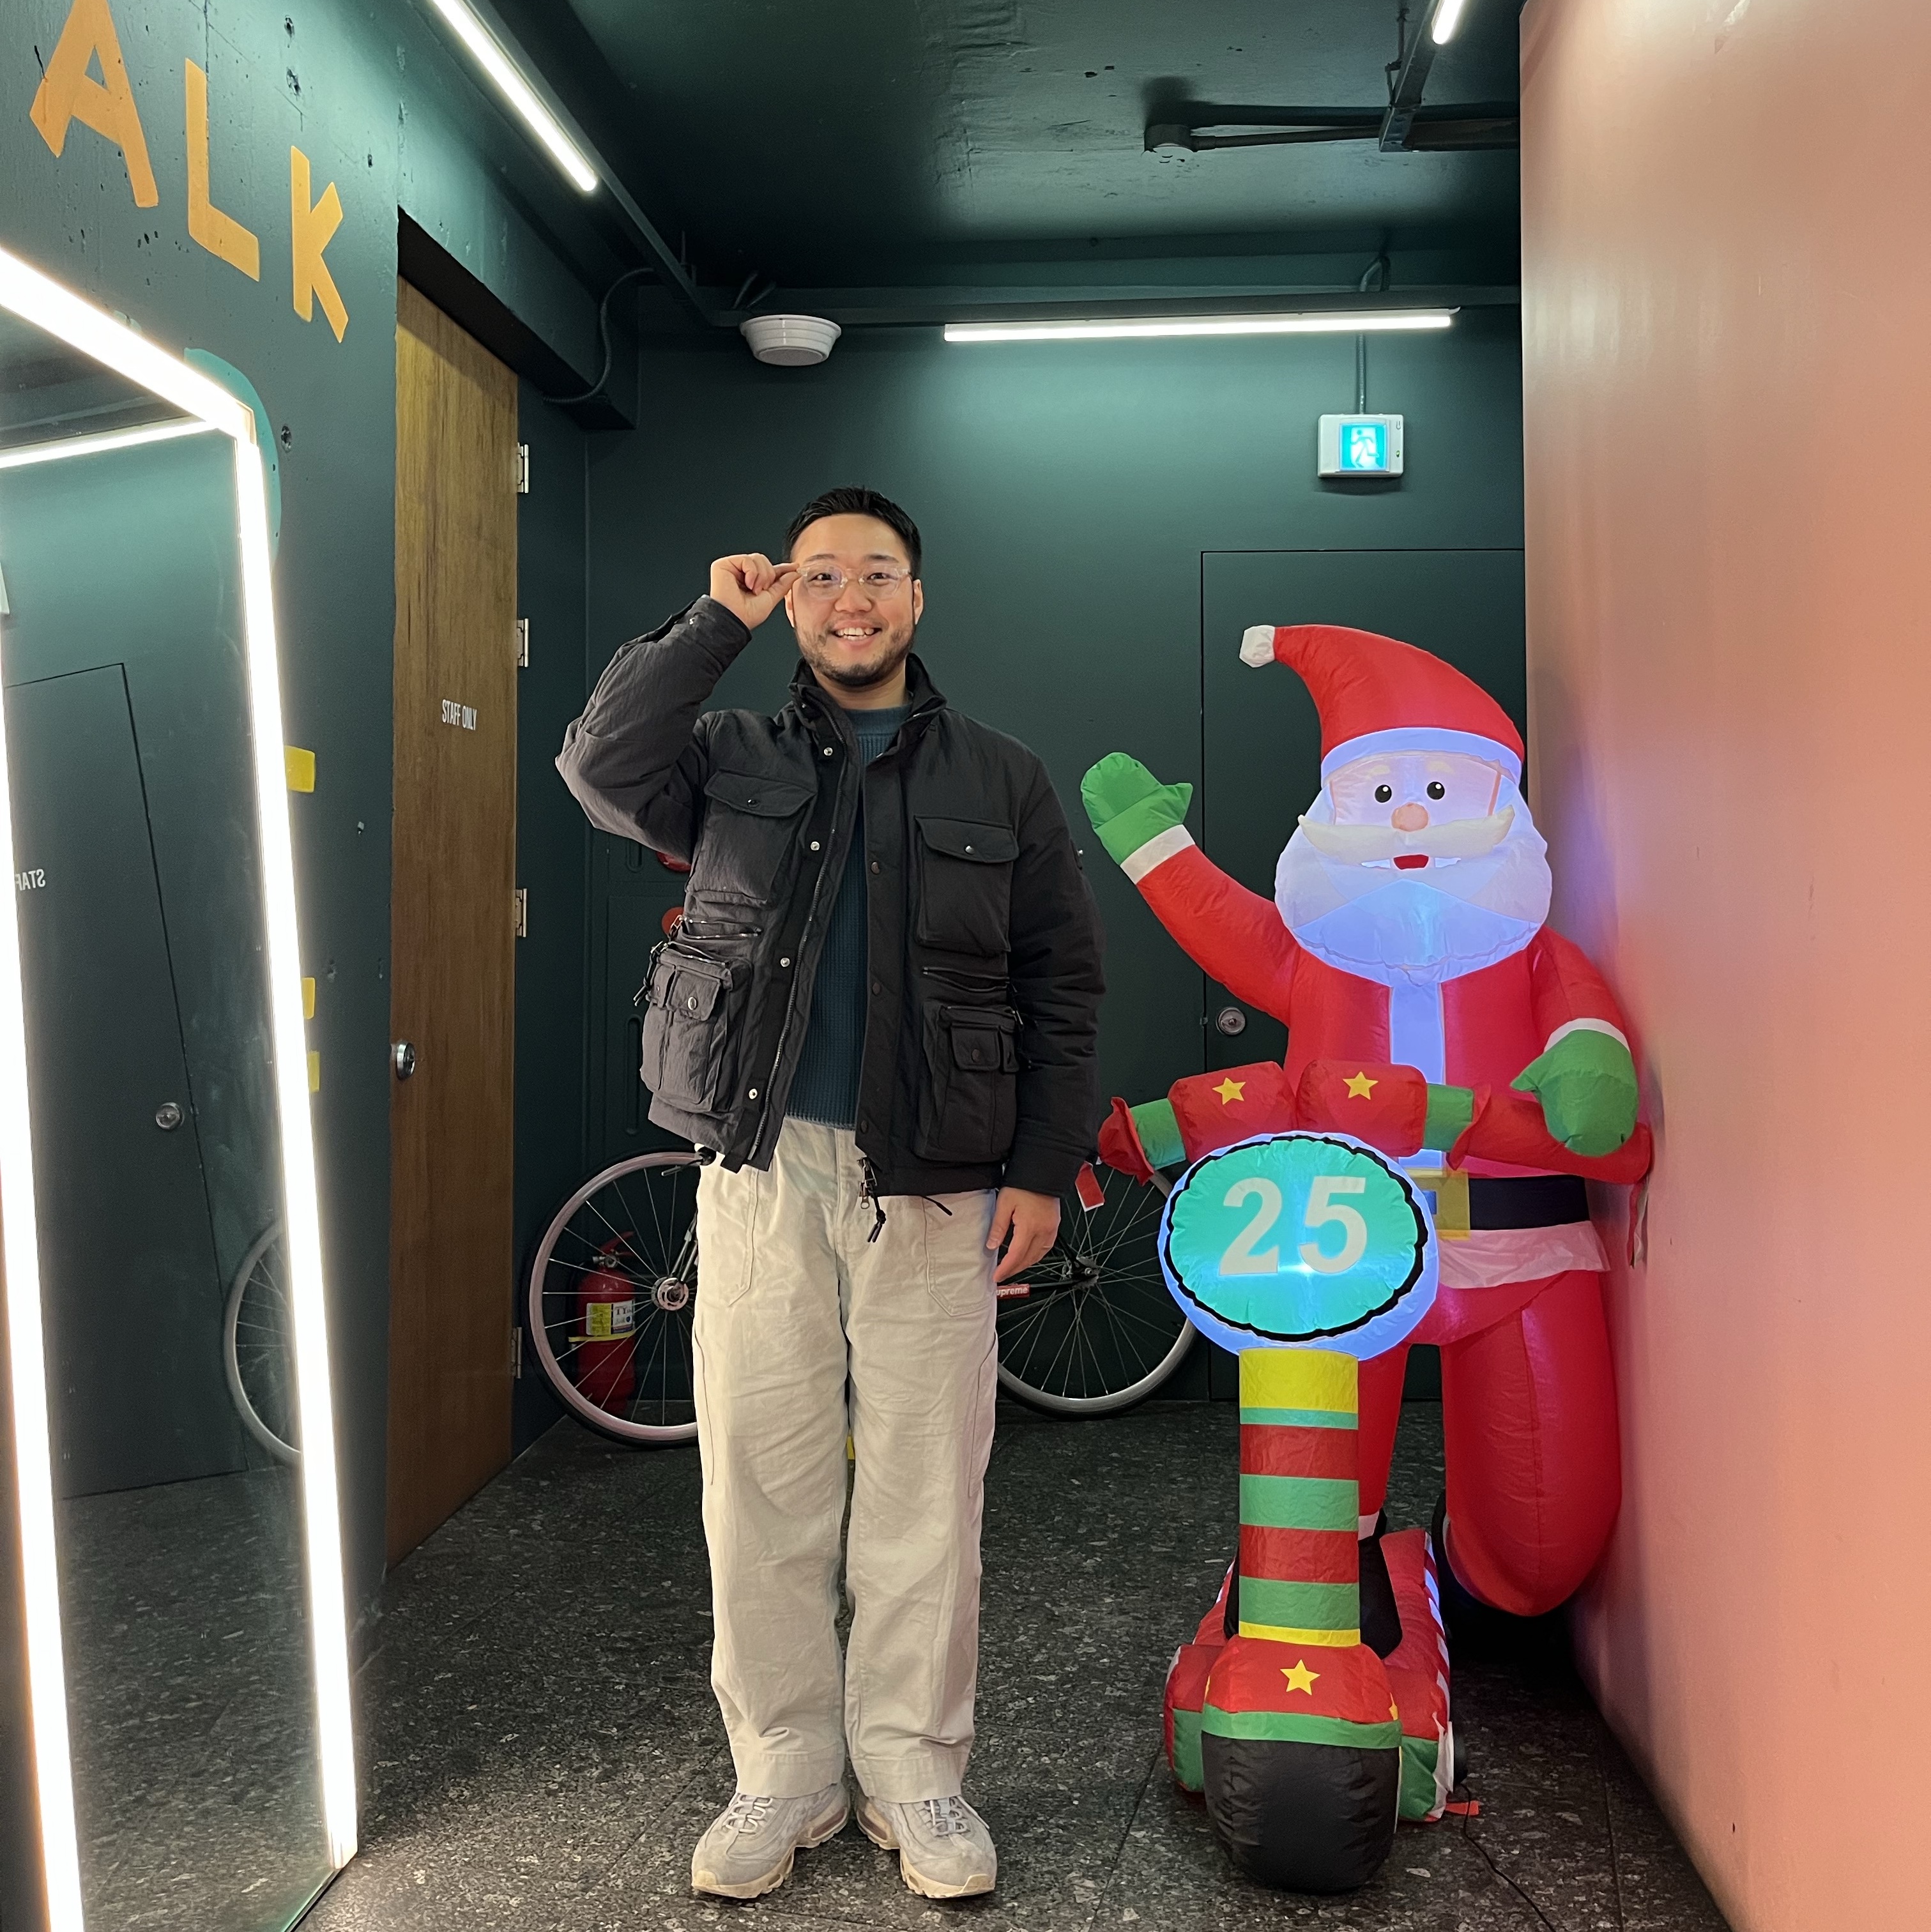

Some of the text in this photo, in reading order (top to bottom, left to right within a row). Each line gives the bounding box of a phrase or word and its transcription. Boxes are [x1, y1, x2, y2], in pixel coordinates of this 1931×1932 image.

[442, 699, 477, 731] STAFF ONLY
[1219, 1175, 1368, 1276] 25
[996, 1286, 1028, 1298] upreme
